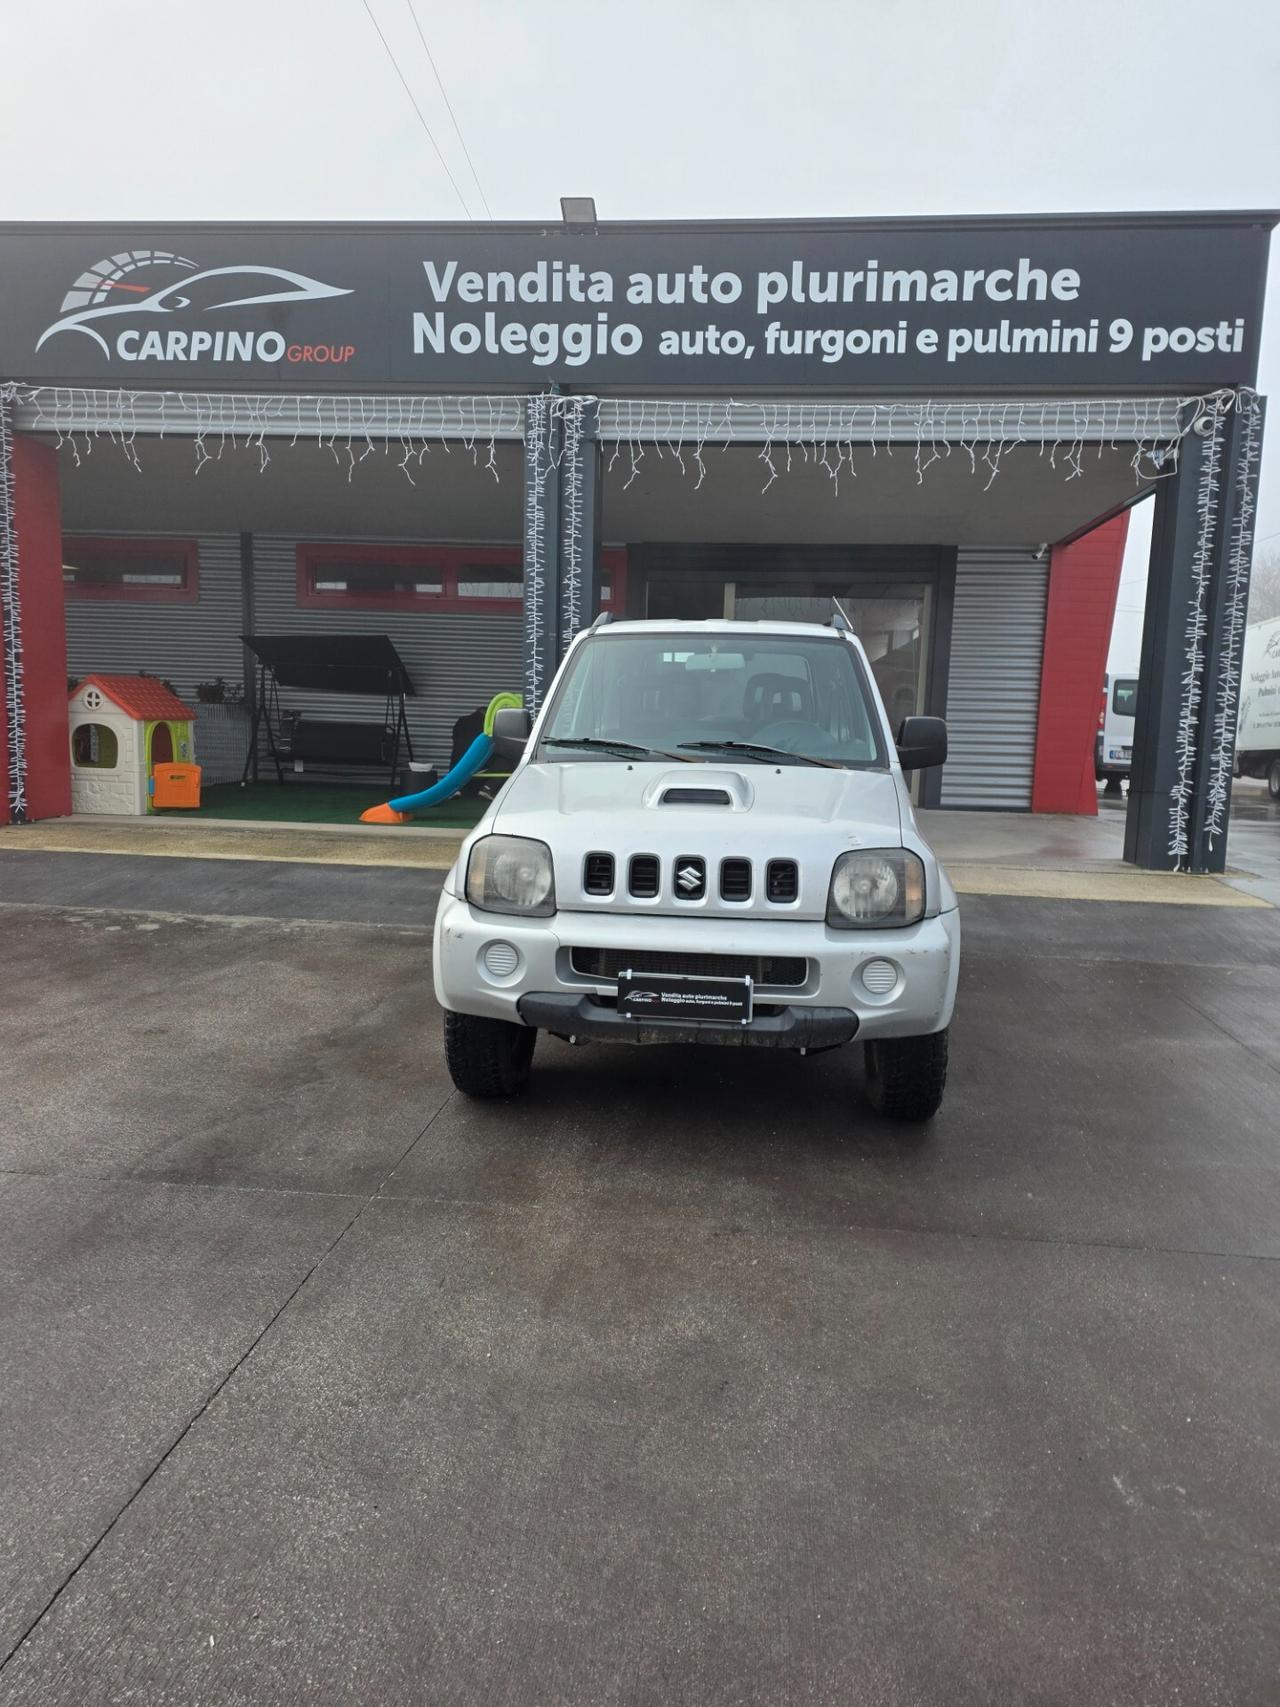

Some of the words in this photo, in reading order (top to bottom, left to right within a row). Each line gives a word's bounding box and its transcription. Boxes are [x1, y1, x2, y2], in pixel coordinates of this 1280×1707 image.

[422, 258, 613, 304] Vendita
[626, 265, 743, 305] auto
[757, 258, 1080, 315] plurimarche
[116, 329, 286, 363] CARPINO
[286, 345, 355, 363] GROUP
[412, 312, 643, 366] Noleggio
[658, 325, 756, 361] auto,
[764, 321, 907, 363] furgoni
[916, 328, 939, 354] e
[946, 319, 1099, 362] pulmini
[1108, 318, 1134, 354] 9
[1142, 318, 1245, 362] posti
